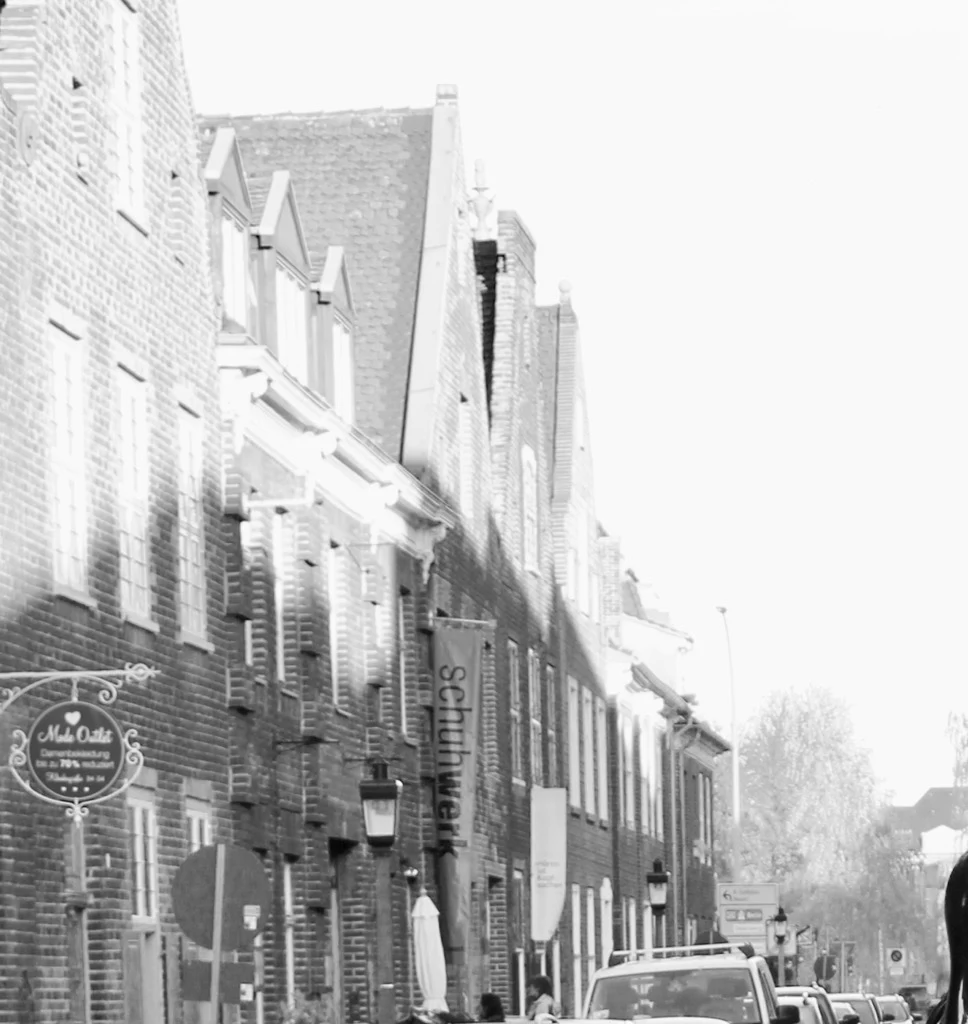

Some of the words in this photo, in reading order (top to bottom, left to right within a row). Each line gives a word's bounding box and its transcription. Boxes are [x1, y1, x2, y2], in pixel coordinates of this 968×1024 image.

[37, 724, 75, 743] Mode
[76, 725, 114, 743] Outlet
[438, 664, 473, 859] schuhwerk
